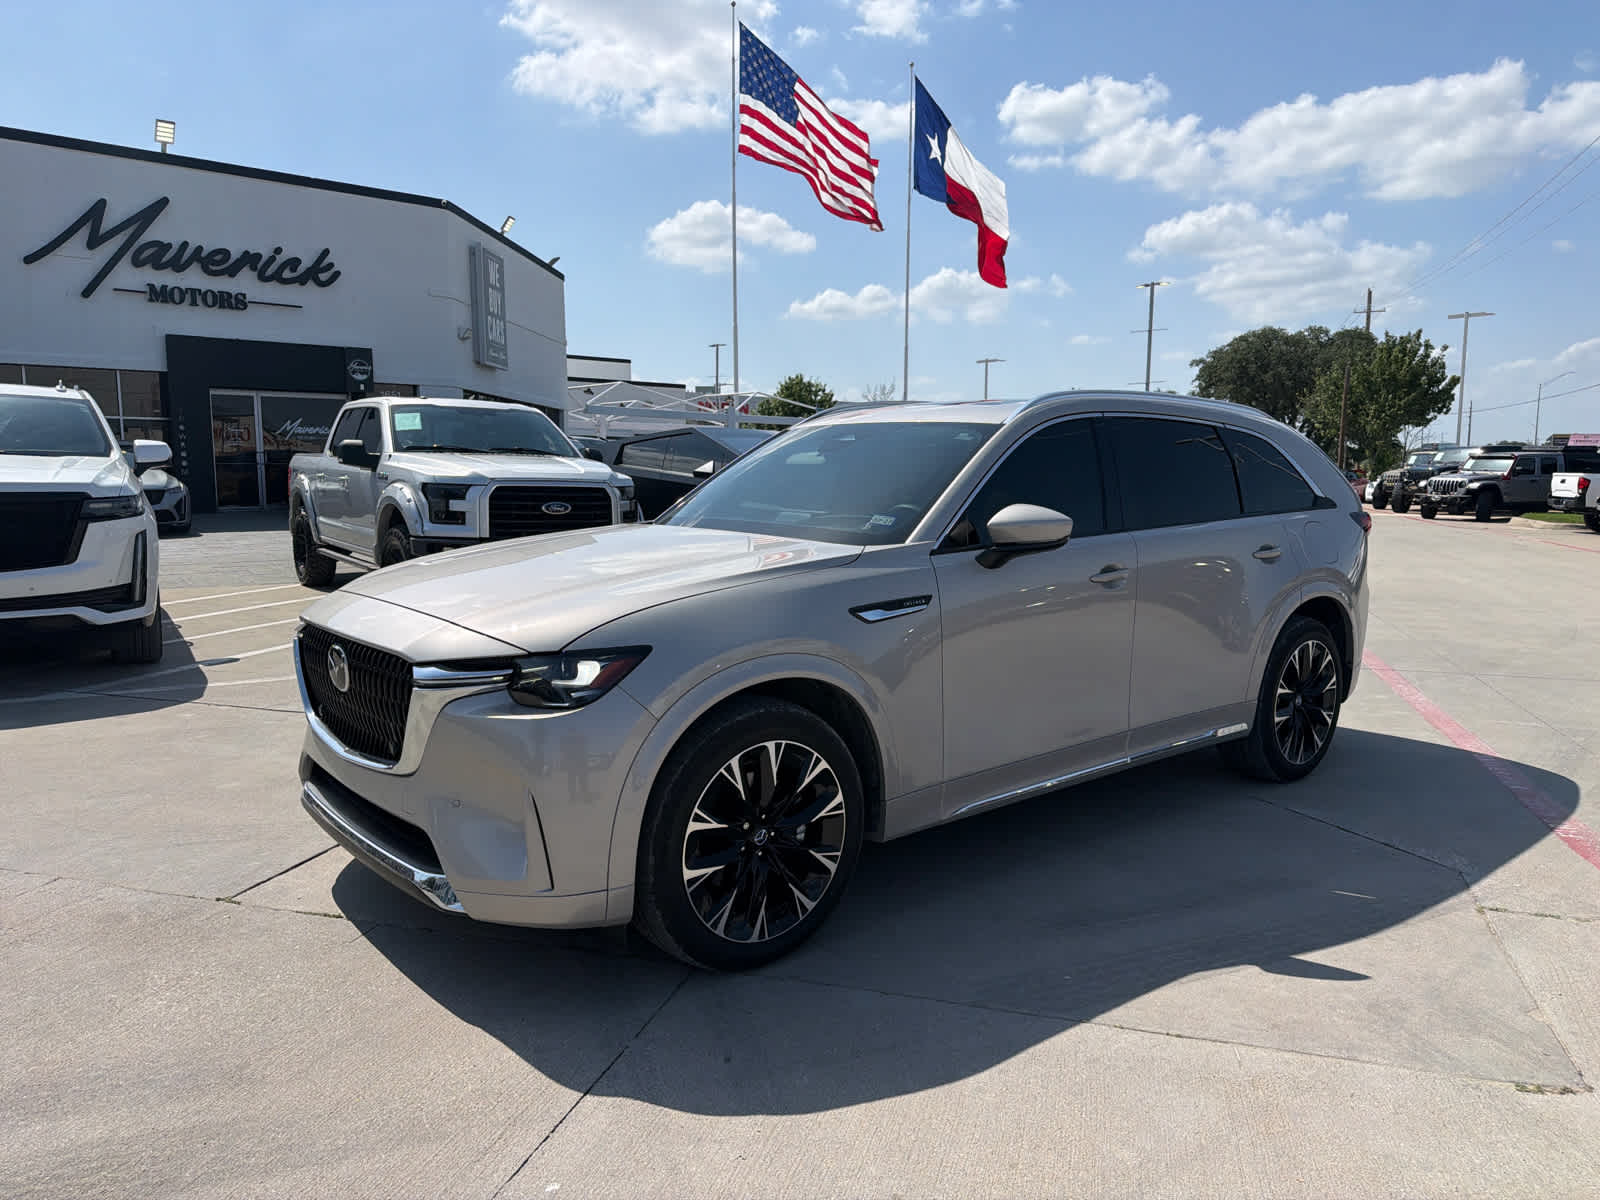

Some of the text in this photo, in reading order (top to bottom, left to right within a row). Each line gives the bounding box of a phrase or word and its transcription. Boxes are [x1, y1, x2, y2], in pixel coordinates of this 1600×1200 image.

[23, 196, 341, 297] Maverick
[487, 259, 500, 288] WE
[146, 283, 248, 311] MOTORS
[488, 287, 501, 317] BUY
[487, 315, 505, 345] CARS
[274, 418, 331, 440] Maveric
